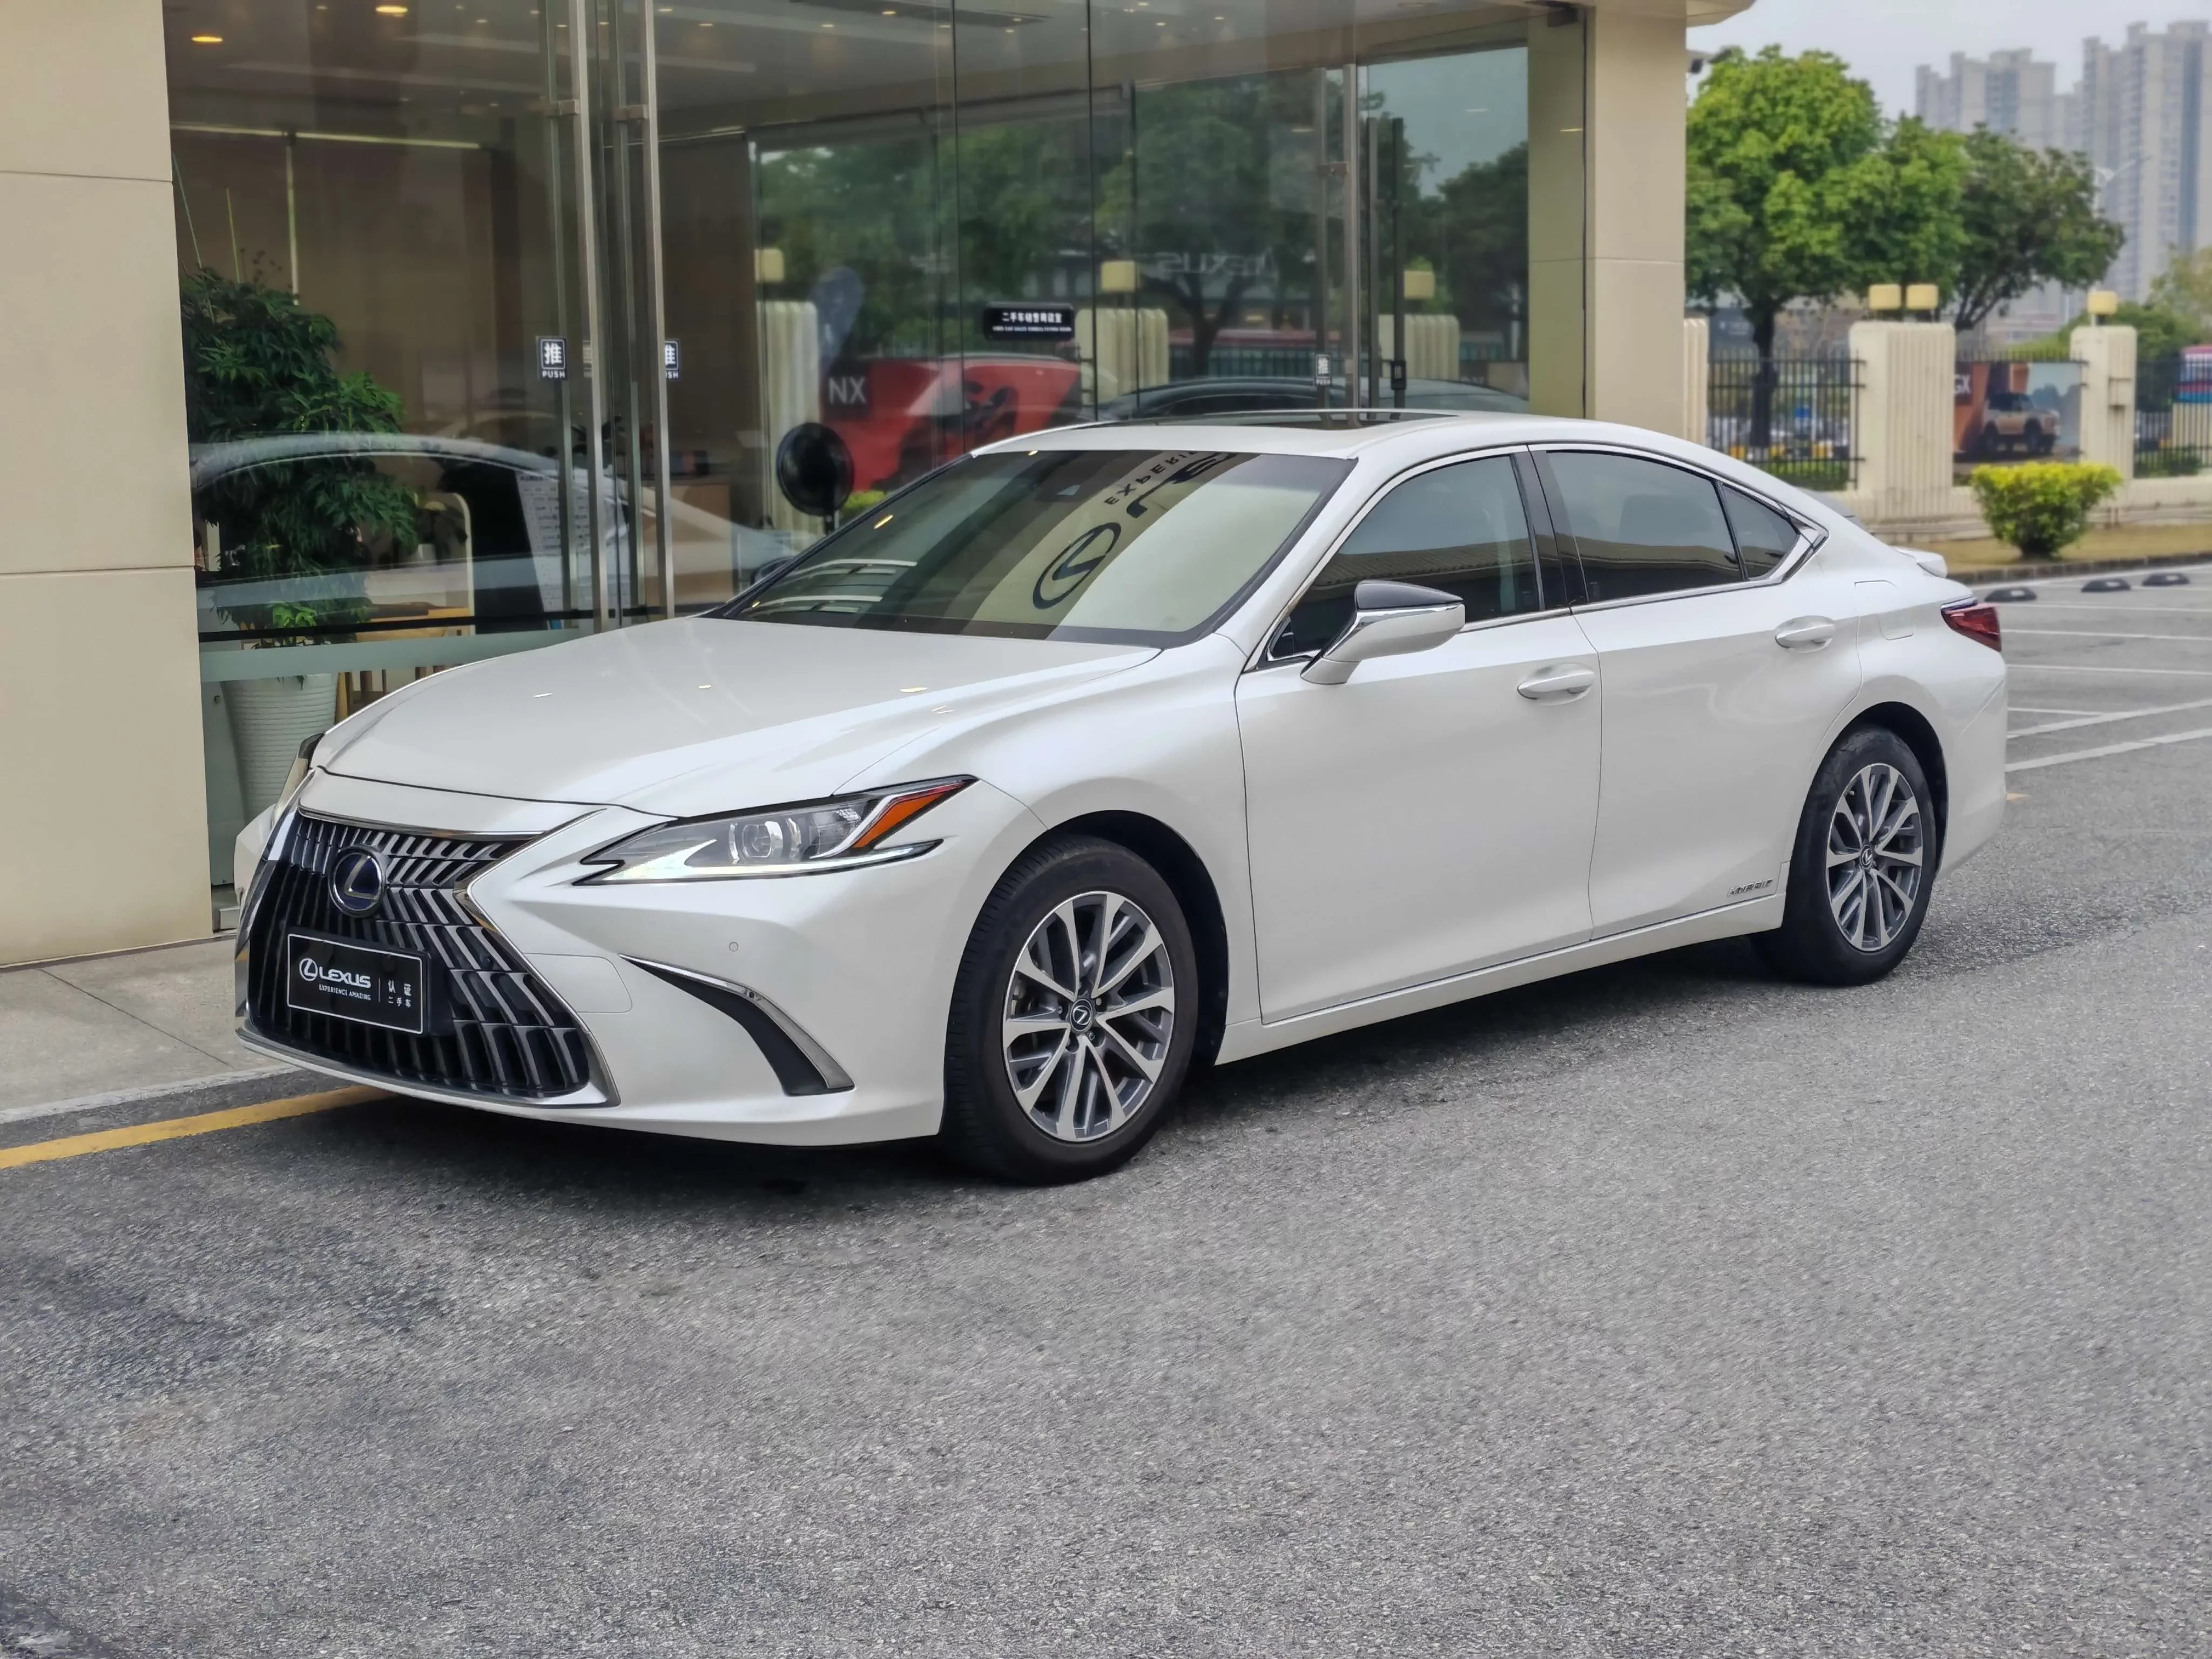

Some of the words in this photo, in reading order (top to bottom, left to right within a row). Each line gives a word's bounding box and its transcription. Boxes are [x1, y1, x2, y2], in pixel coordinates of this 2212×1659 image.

[544, 342, 562, 365] 推
[542, 370, 565, 379] PUSH
[829, 376, 867, 404] NX
[319, 966, 372, 988] LEXUS
[319, 983, 348, 996] EXPERIENCE
[349, 991, 372, 1001] AMAZING
